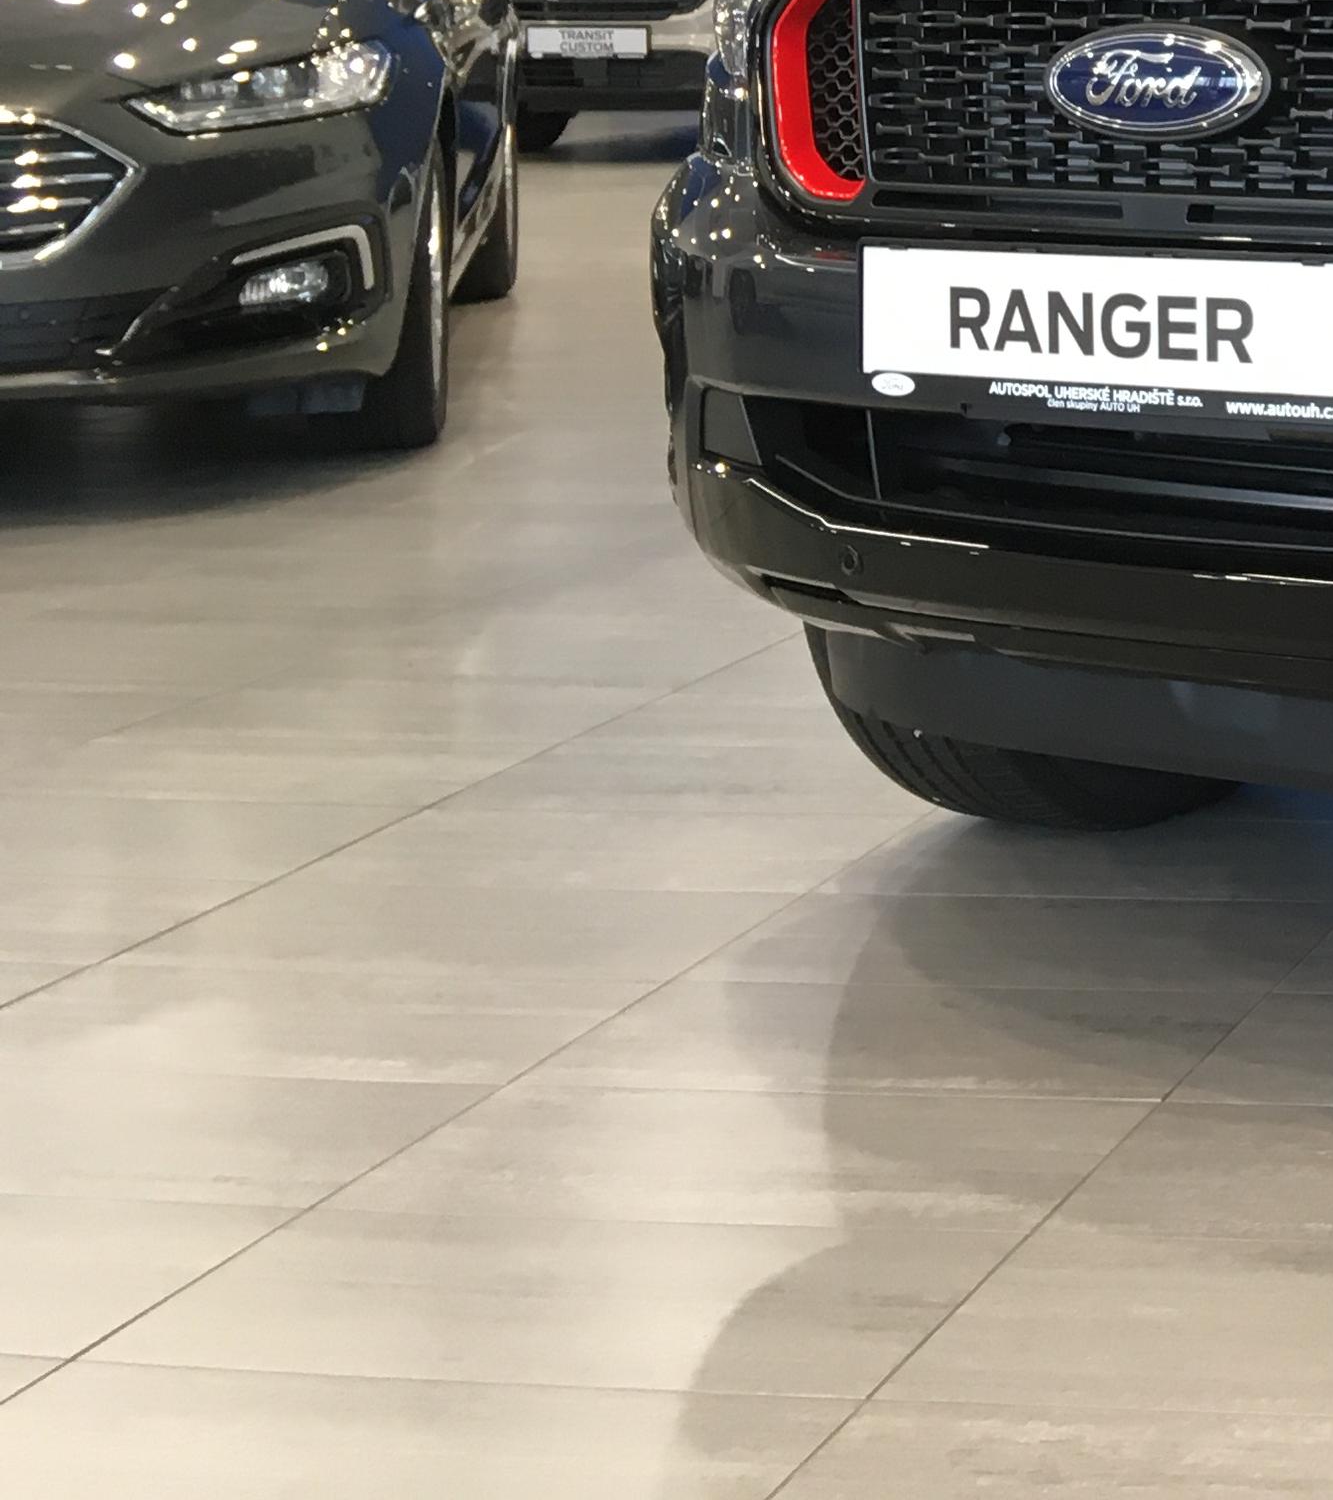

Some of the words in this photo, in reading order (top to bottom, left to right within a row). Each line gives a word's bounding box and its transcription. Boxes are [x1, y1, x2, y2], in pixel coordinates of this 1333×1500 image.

[558, 30, 614, 41] TRANSIT
[559, 41, 614, 52] CUSTOM
[1085, 49, 1202, 109] Ford
[948, 286, 1254, 364] RANGER
[989, 381, 1050, 398] AUTOSPOL
[1054, 383, 1111, 402] UHERSKÉ
[1113, 386, 1175, 406] HRADIŠTĚ
[1177, 394, 1204, 407] s.r.o.
[1047, 398, 1065, 409] člen
[1067, 399, 1098, 412] skupiny
[1099, 401, 1125, 412] AUTO
[1127, 403, 1141, 413] UH
